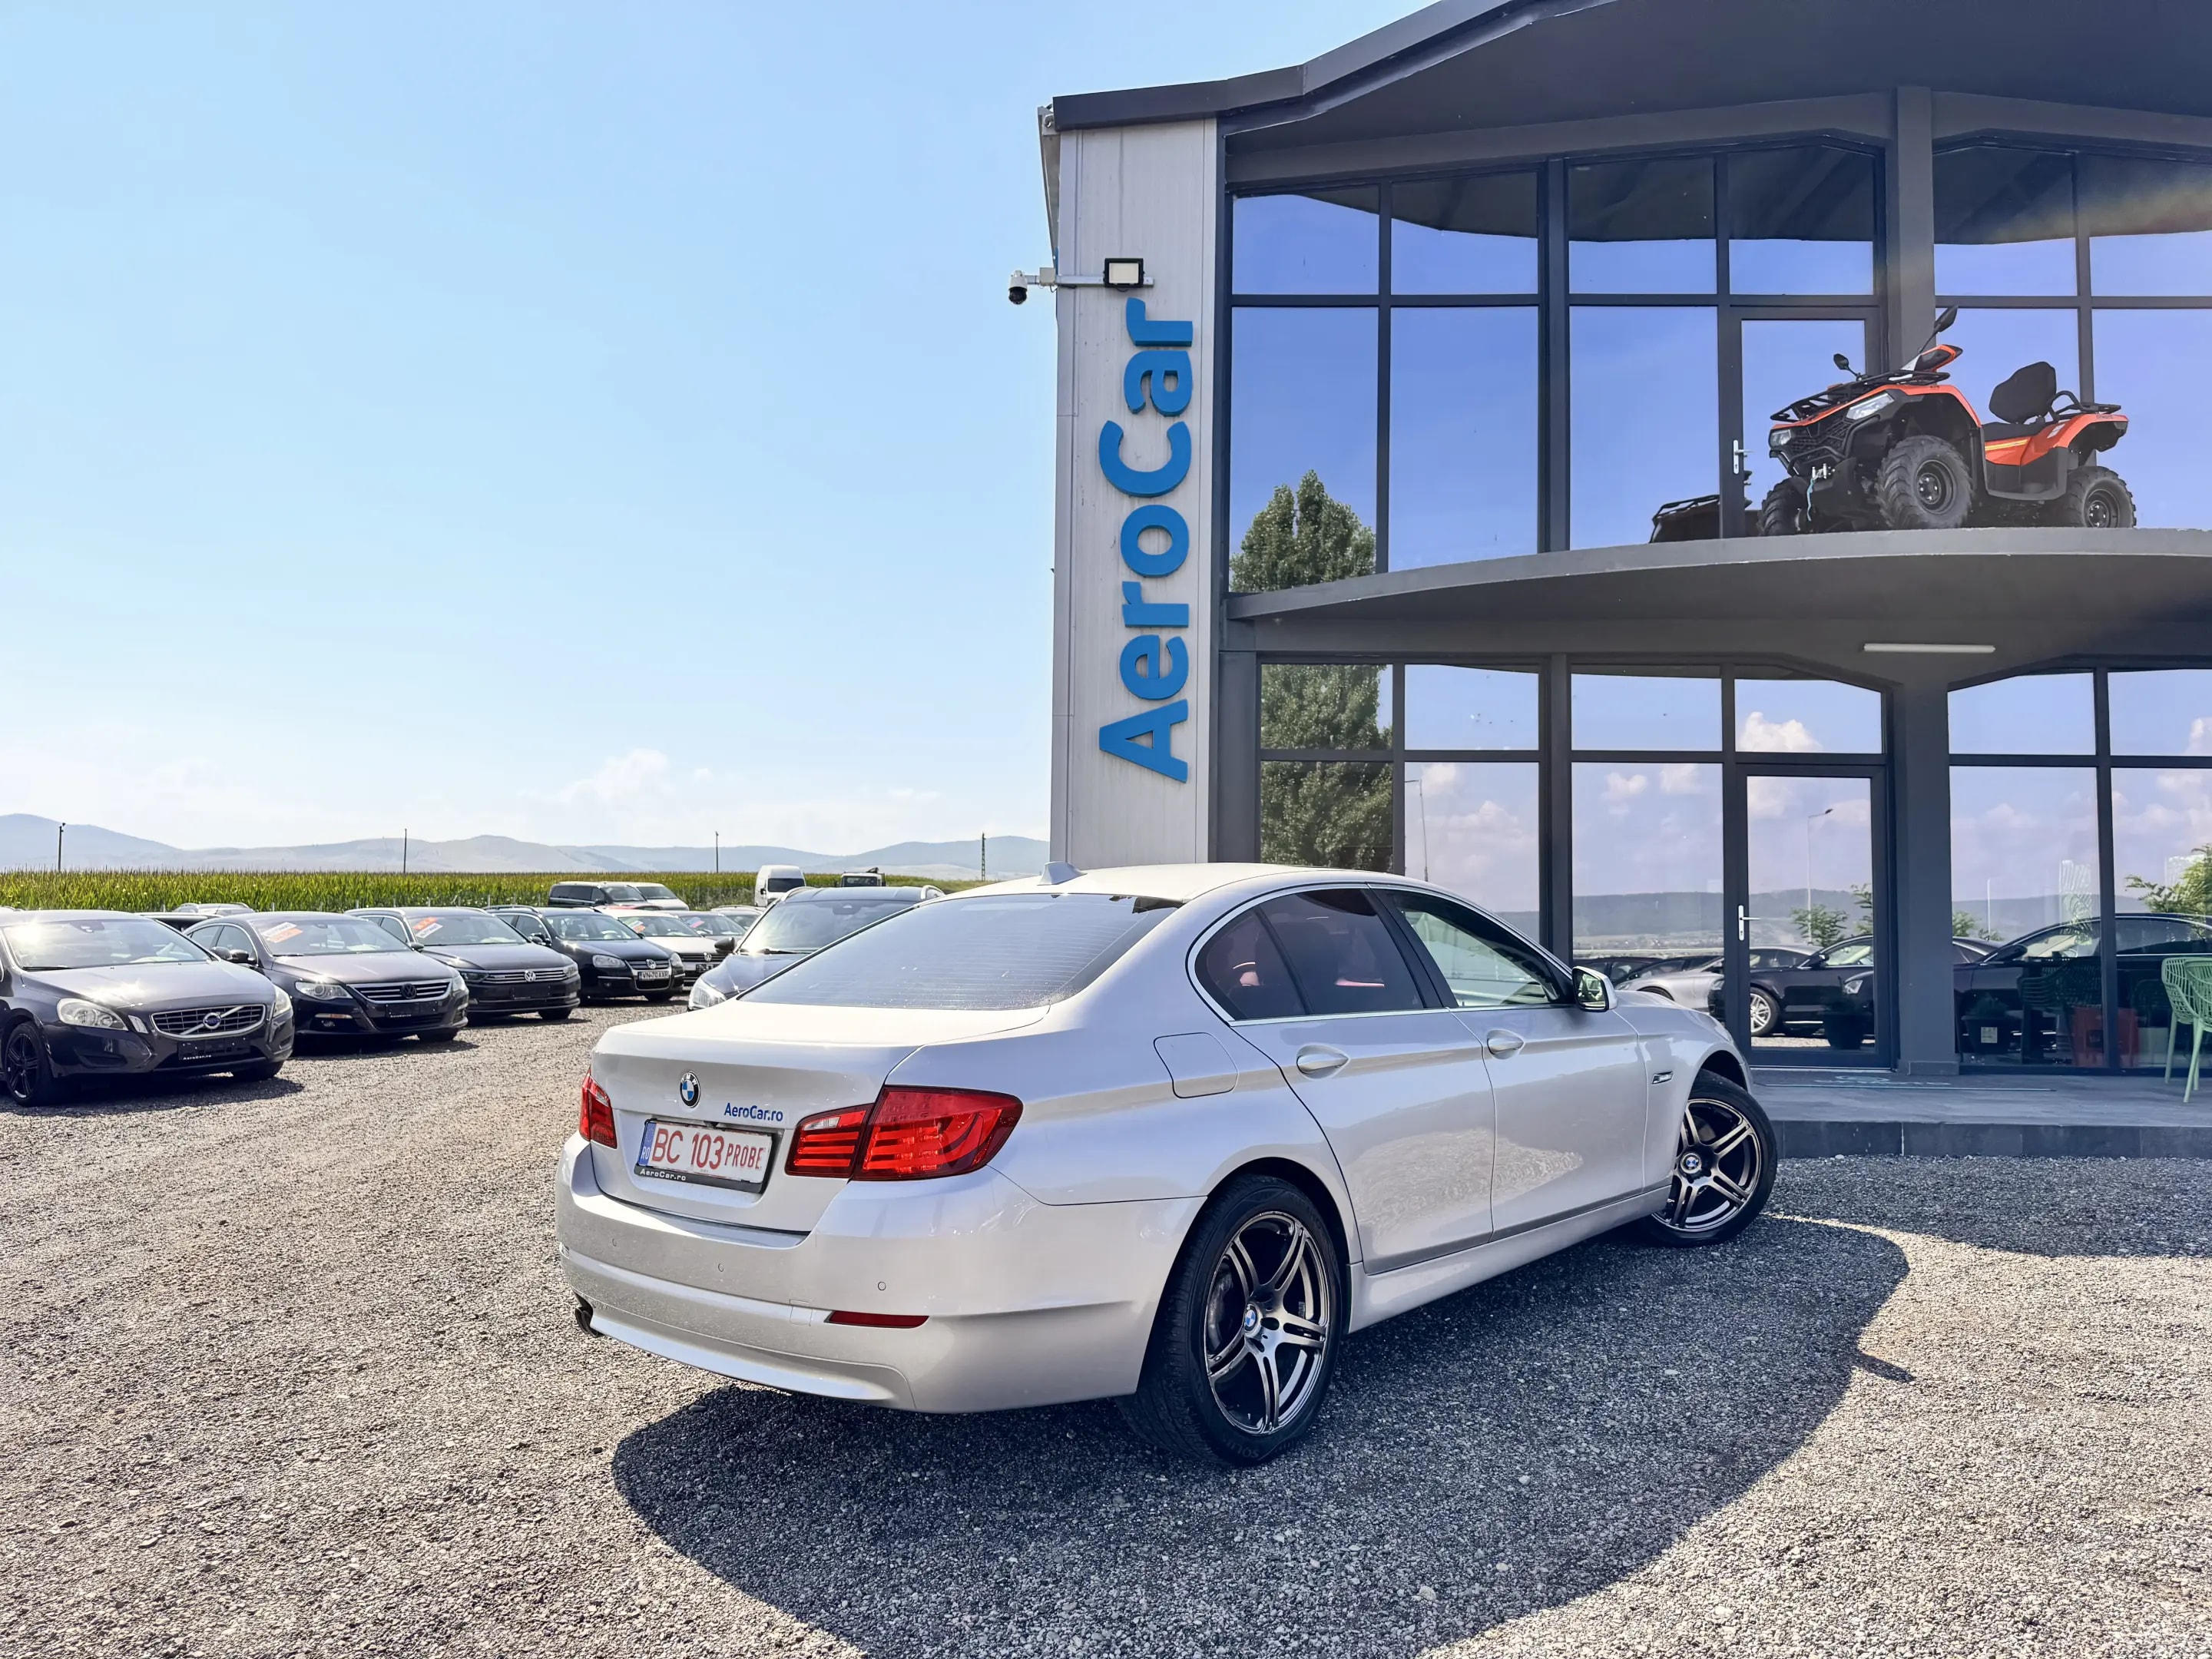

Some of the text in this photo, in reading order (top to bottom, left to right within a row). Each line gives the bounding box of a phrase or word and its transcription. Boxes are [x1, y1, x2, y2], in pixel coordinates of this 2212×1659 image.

[1098, 297, 1194, 783] AeroCar
[724, 1102, 783, 1121] AeroCar.ro
[640, 1146, 651, 1160] RO
[651, 1128, 763, 1170] BC 103 PROBE
[640, 1168, 687, 1181] AeroCar.ro
